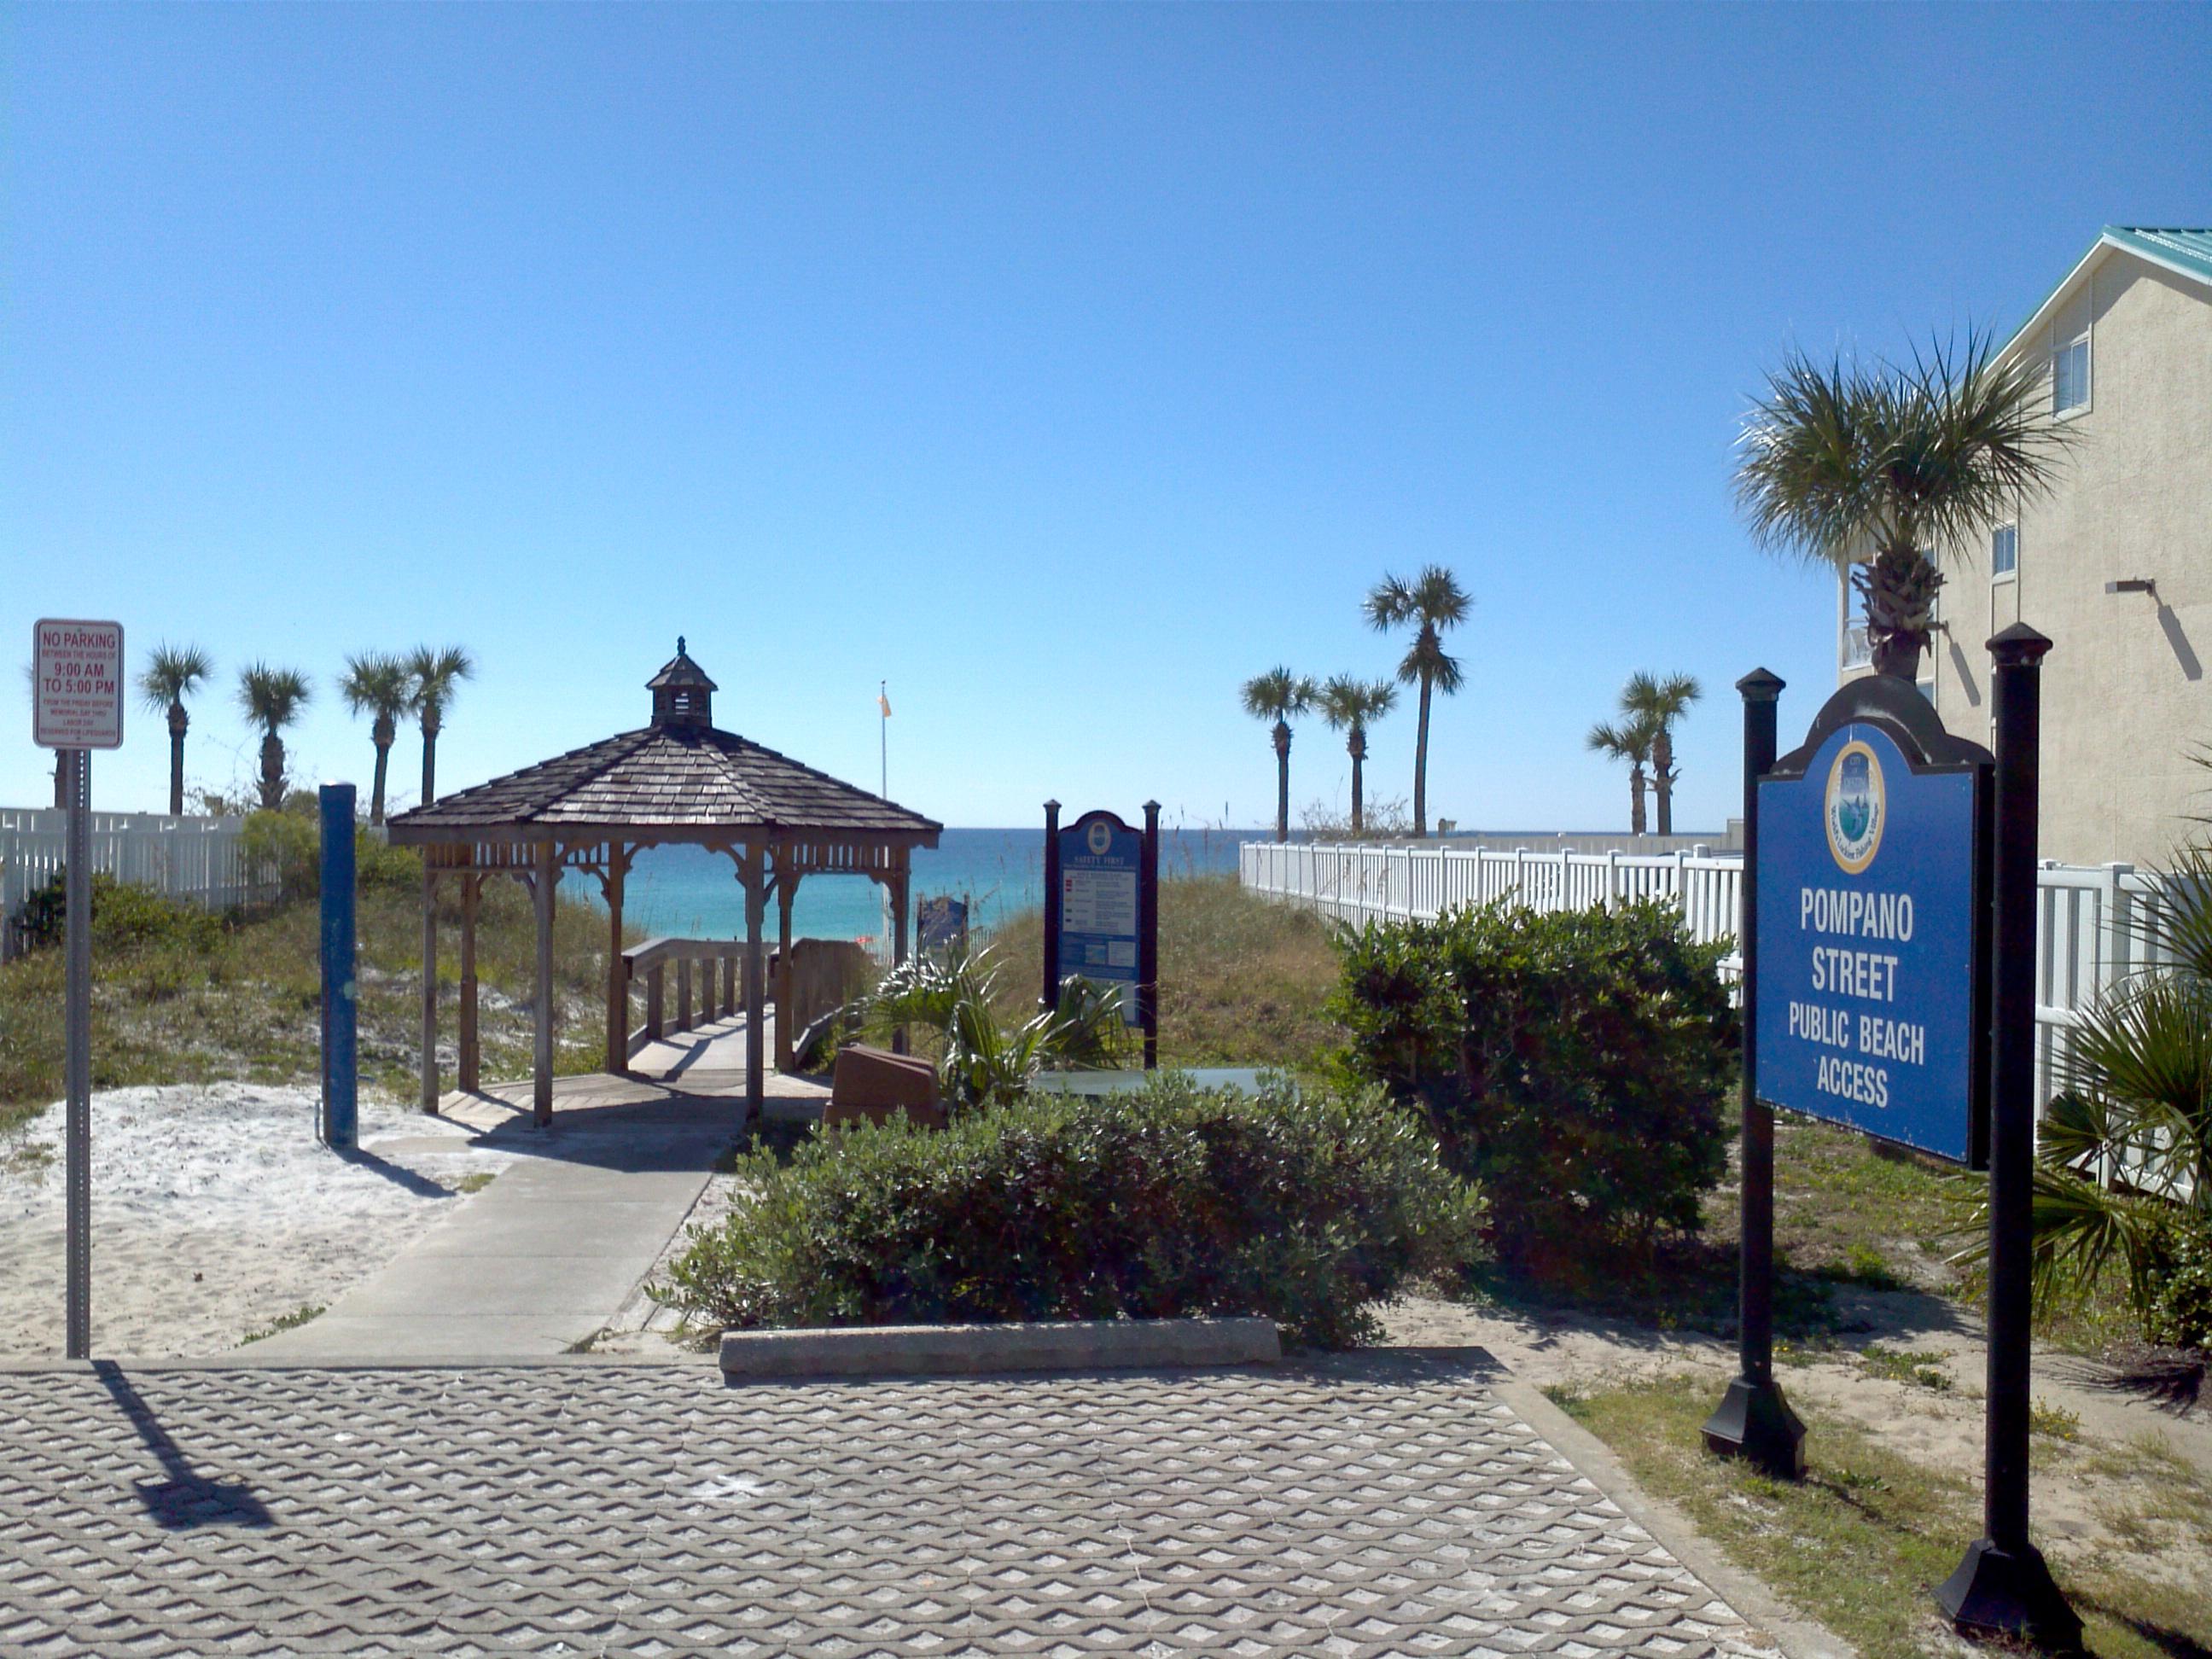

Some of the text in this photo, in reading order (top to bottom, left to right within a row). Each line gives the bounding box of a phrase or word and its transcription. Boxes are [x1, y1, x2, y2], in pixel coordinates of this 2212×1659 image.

[43, 632, 115, 649] NO PARKING
[44, 678, 114, 695] TO 5:00 PM
[55, 662, 104, 677] 9:00 AM
[1801, 888, 1913, 942] POMPANO
[1812, 946, 1898, 1002] STREET
[1789, 1001, 1924, 1066] PUBLIC BEACH
[1817, 1056, 1888, 1109] ACCESS
